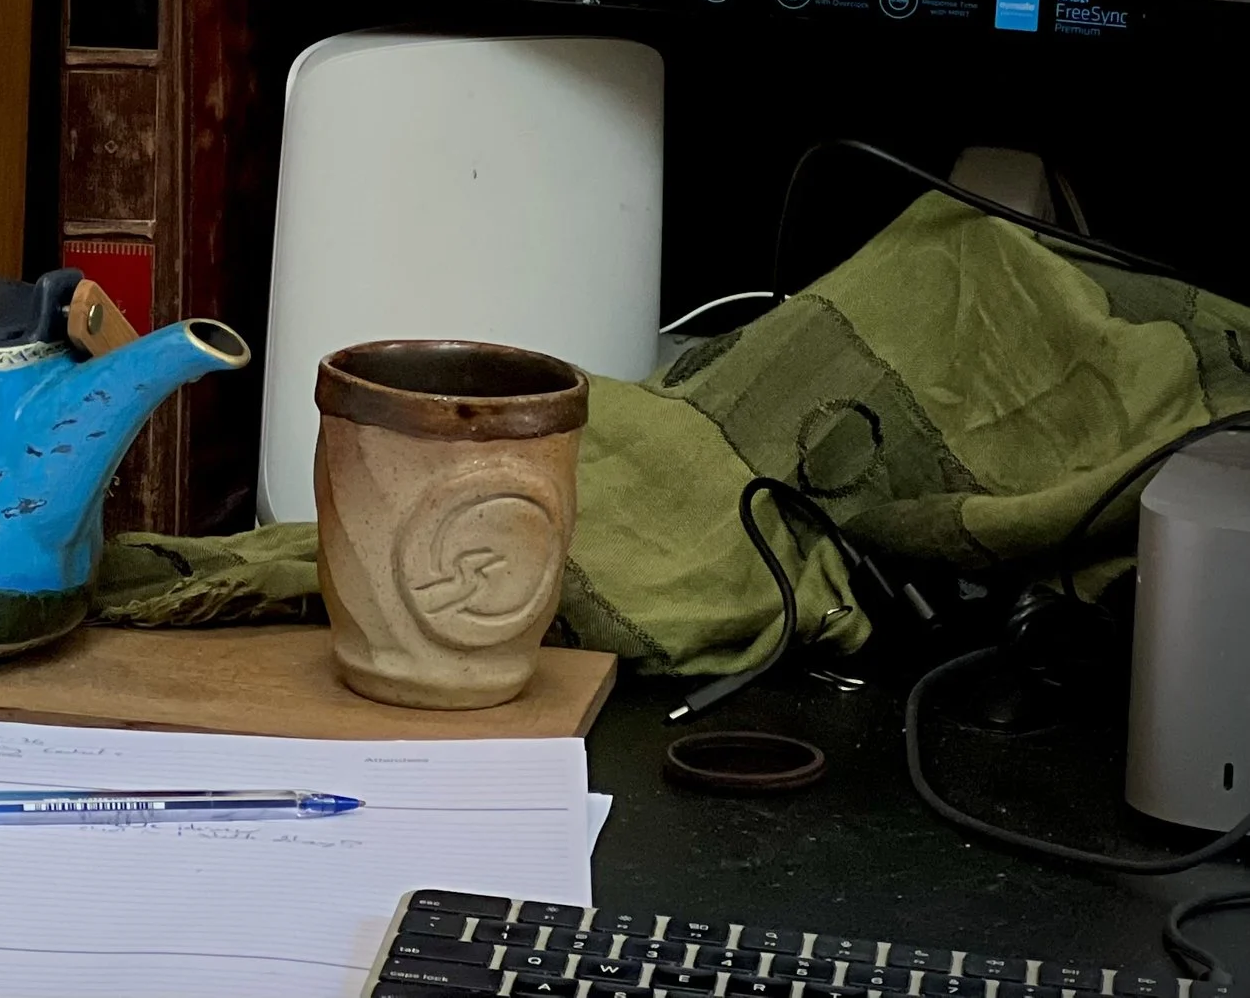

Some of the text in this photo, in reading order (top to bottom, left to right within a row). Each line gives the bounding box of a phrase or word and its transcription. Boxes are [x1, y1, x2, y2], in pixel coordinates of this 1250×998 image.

[1056, 3, 1128, 26] FreeSync
[400, 946, 420, 954] tab
[528, 957, 542, 965] Q
[600, 964, 620, 973] W
[537, 983, 551, 991] A
